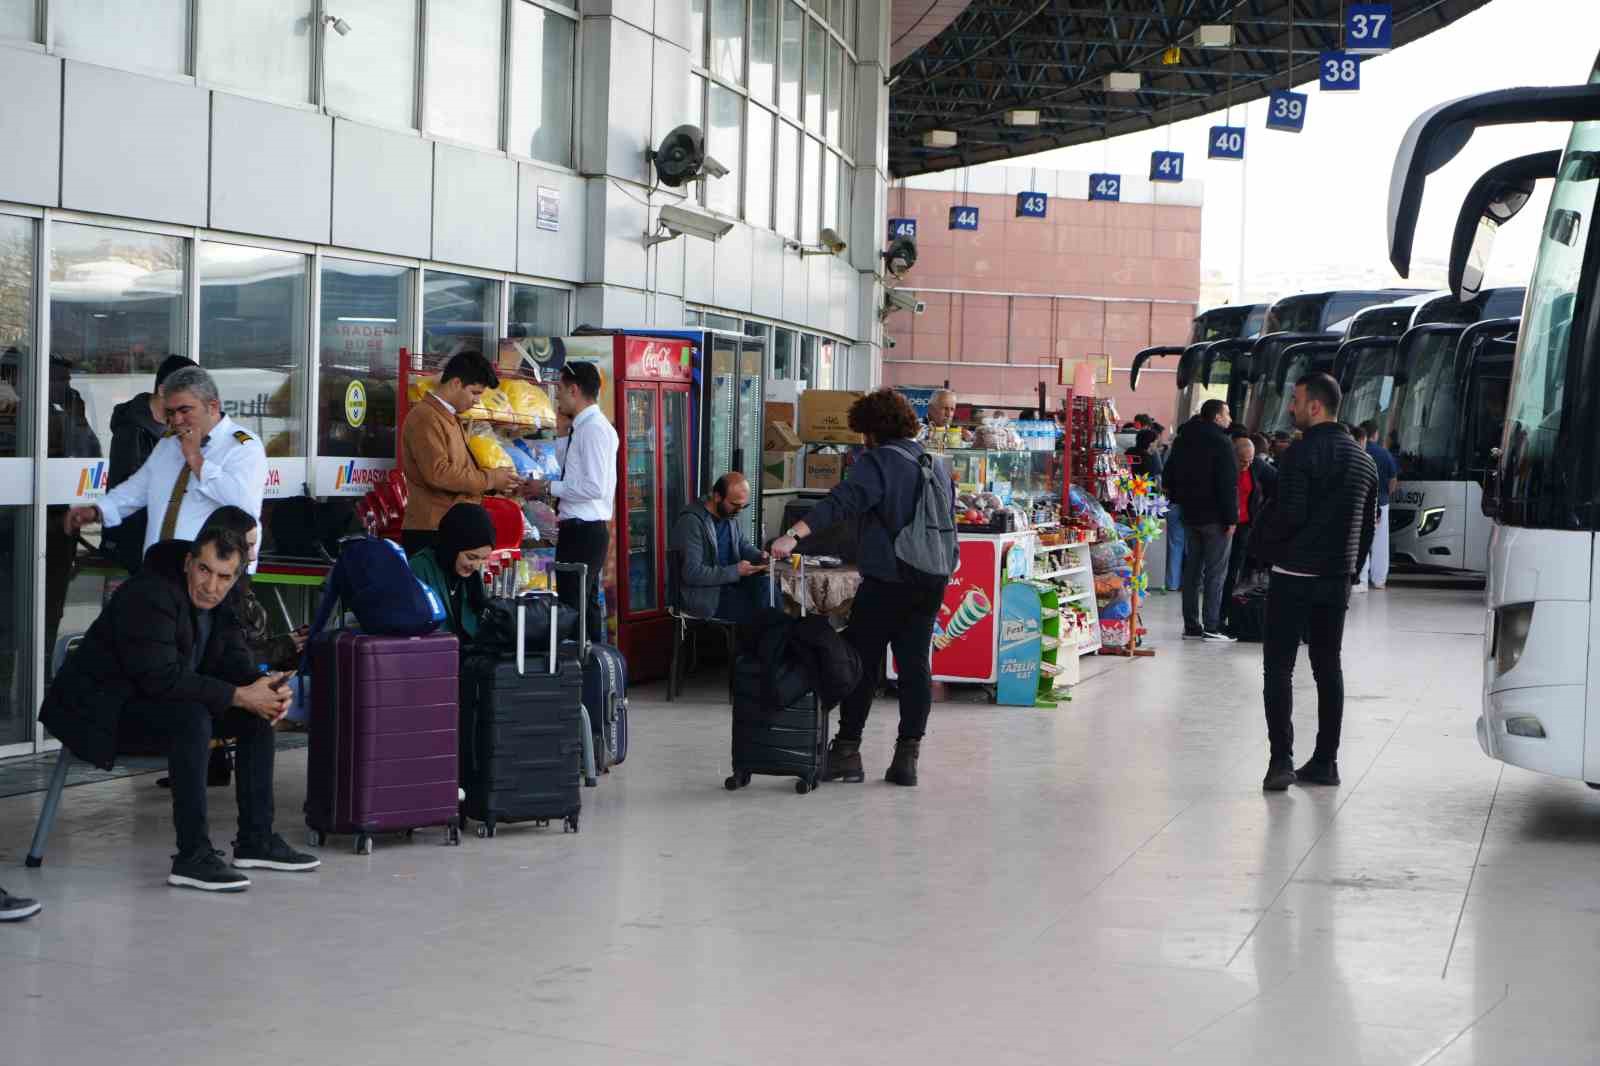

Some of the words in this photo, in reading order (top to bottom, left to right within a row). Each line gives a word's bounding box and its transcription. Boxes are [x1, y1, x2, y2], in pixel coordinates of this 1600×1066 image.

[1352, 14, 1387, 39] 37
[1325, 59, 1356, 82] 38
[1274, 98, 1302, 120] 39
[1215, 133, 1241, 151] 40
[1160, 157, 1181, 175] 41
[1096, 179, 1118, 195] 42
[1024, 198, 1044, 212] 43
[957, 211, 976, 225] 44
[896, 223, 914, 236] 45
